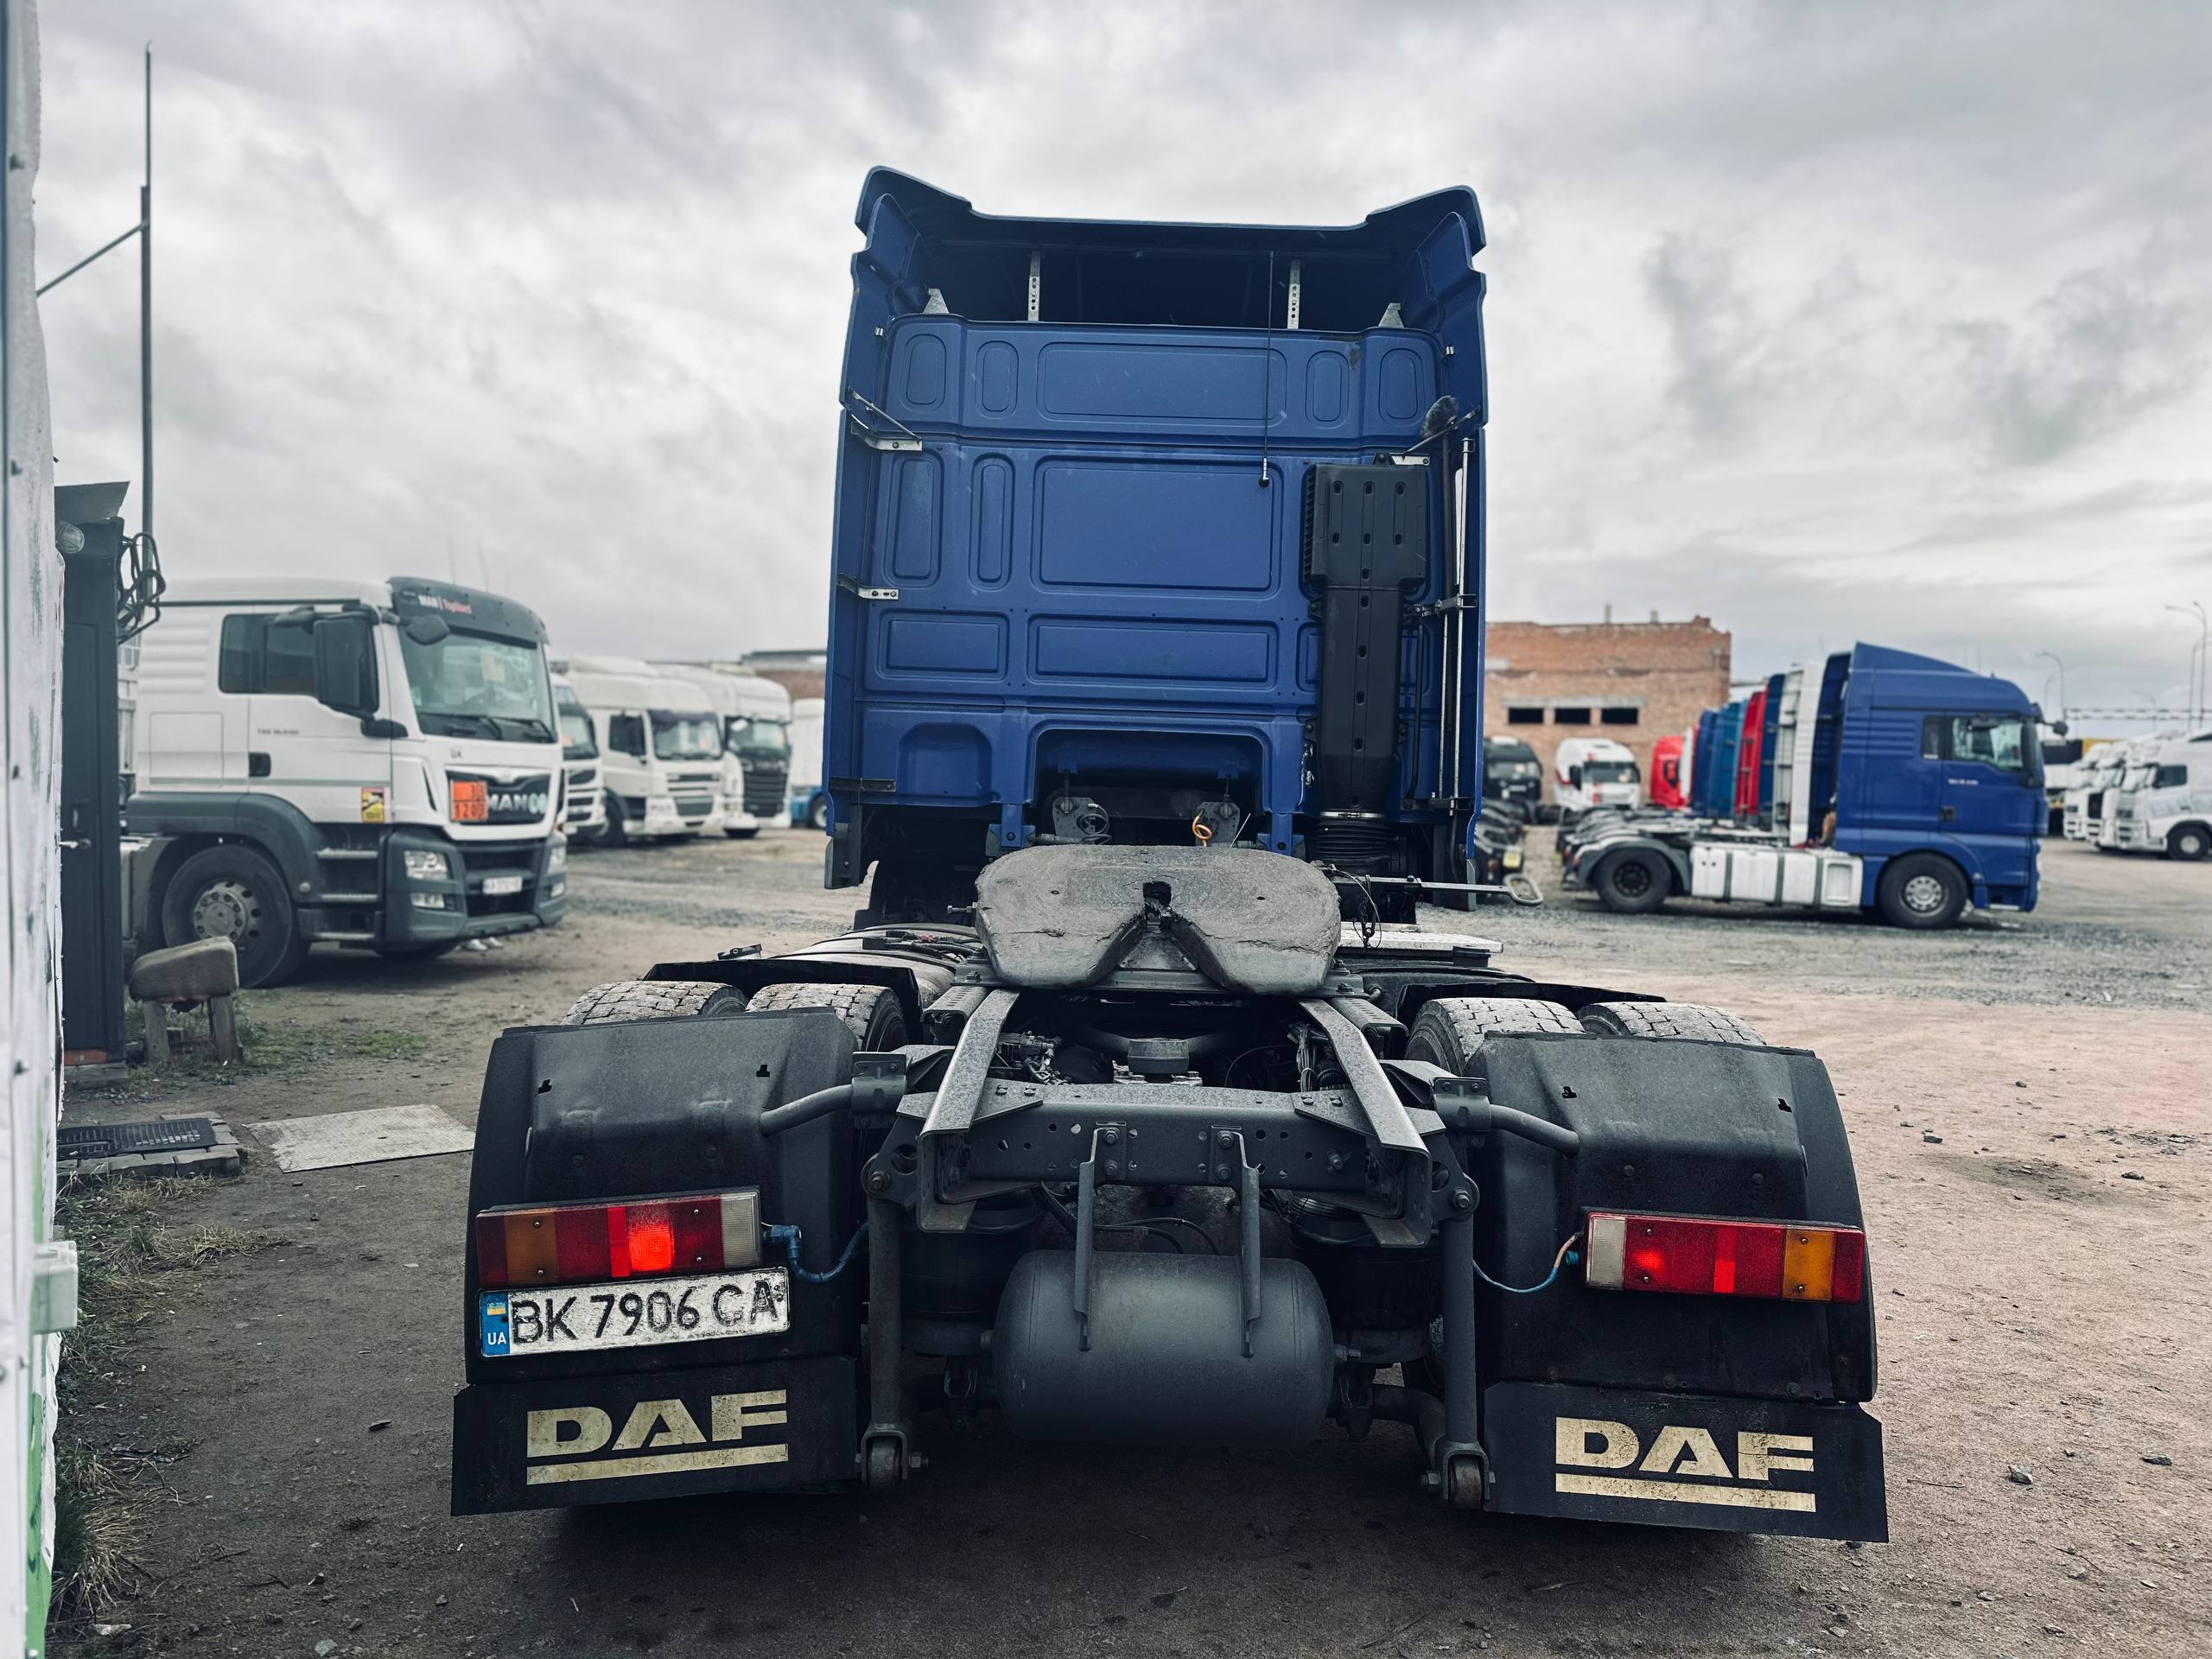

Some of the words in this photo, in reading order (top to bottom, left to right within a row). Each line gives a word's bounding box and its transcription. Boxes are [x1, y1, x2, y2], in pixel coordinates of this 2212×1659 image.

[487, 1332, 506, 1345] UA
[511, 1297, 578, 1344] BK
[590, 1285, 701, 1338] 7906
[711, 1280, 779, 1326] CA
[526, 1389, 788, 1458] DAF
[1555, 1416, 1815, 1481] DAF
